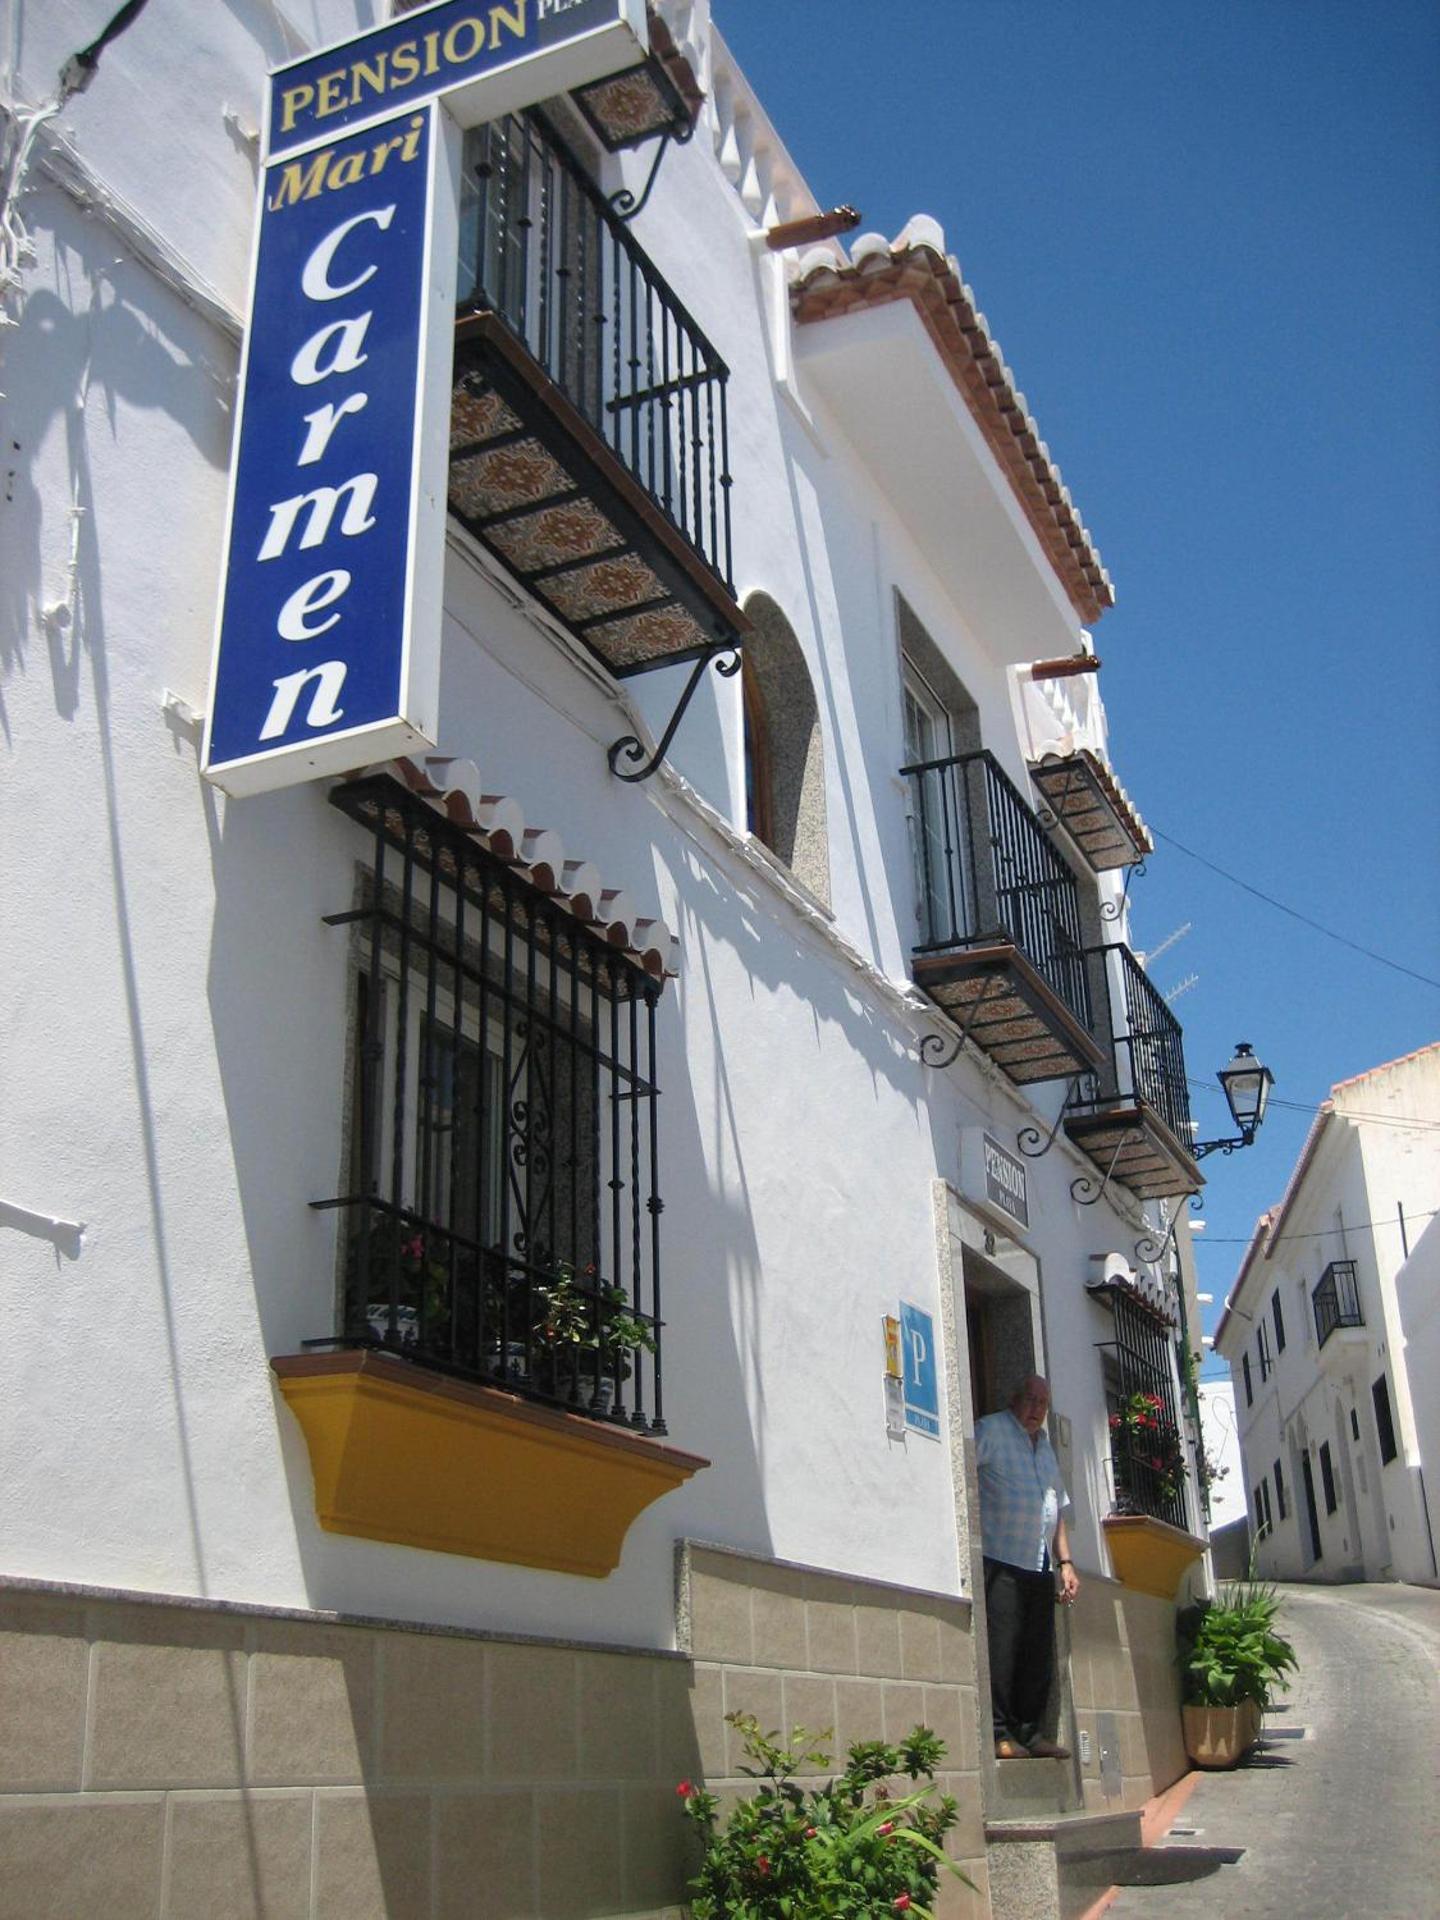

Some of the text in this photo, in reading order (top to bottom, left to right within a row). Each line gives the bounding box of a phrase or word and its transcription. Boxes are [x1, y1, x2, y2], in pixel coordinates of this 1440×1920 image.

[280, 0, 526, 133] PENSION
[268, 116, 423, 212] Mari
[257, 204, 396, 741] Carmen
[984, 1142, 1025, 1202] PENSION
[910, 1328, 927, 1386] P
